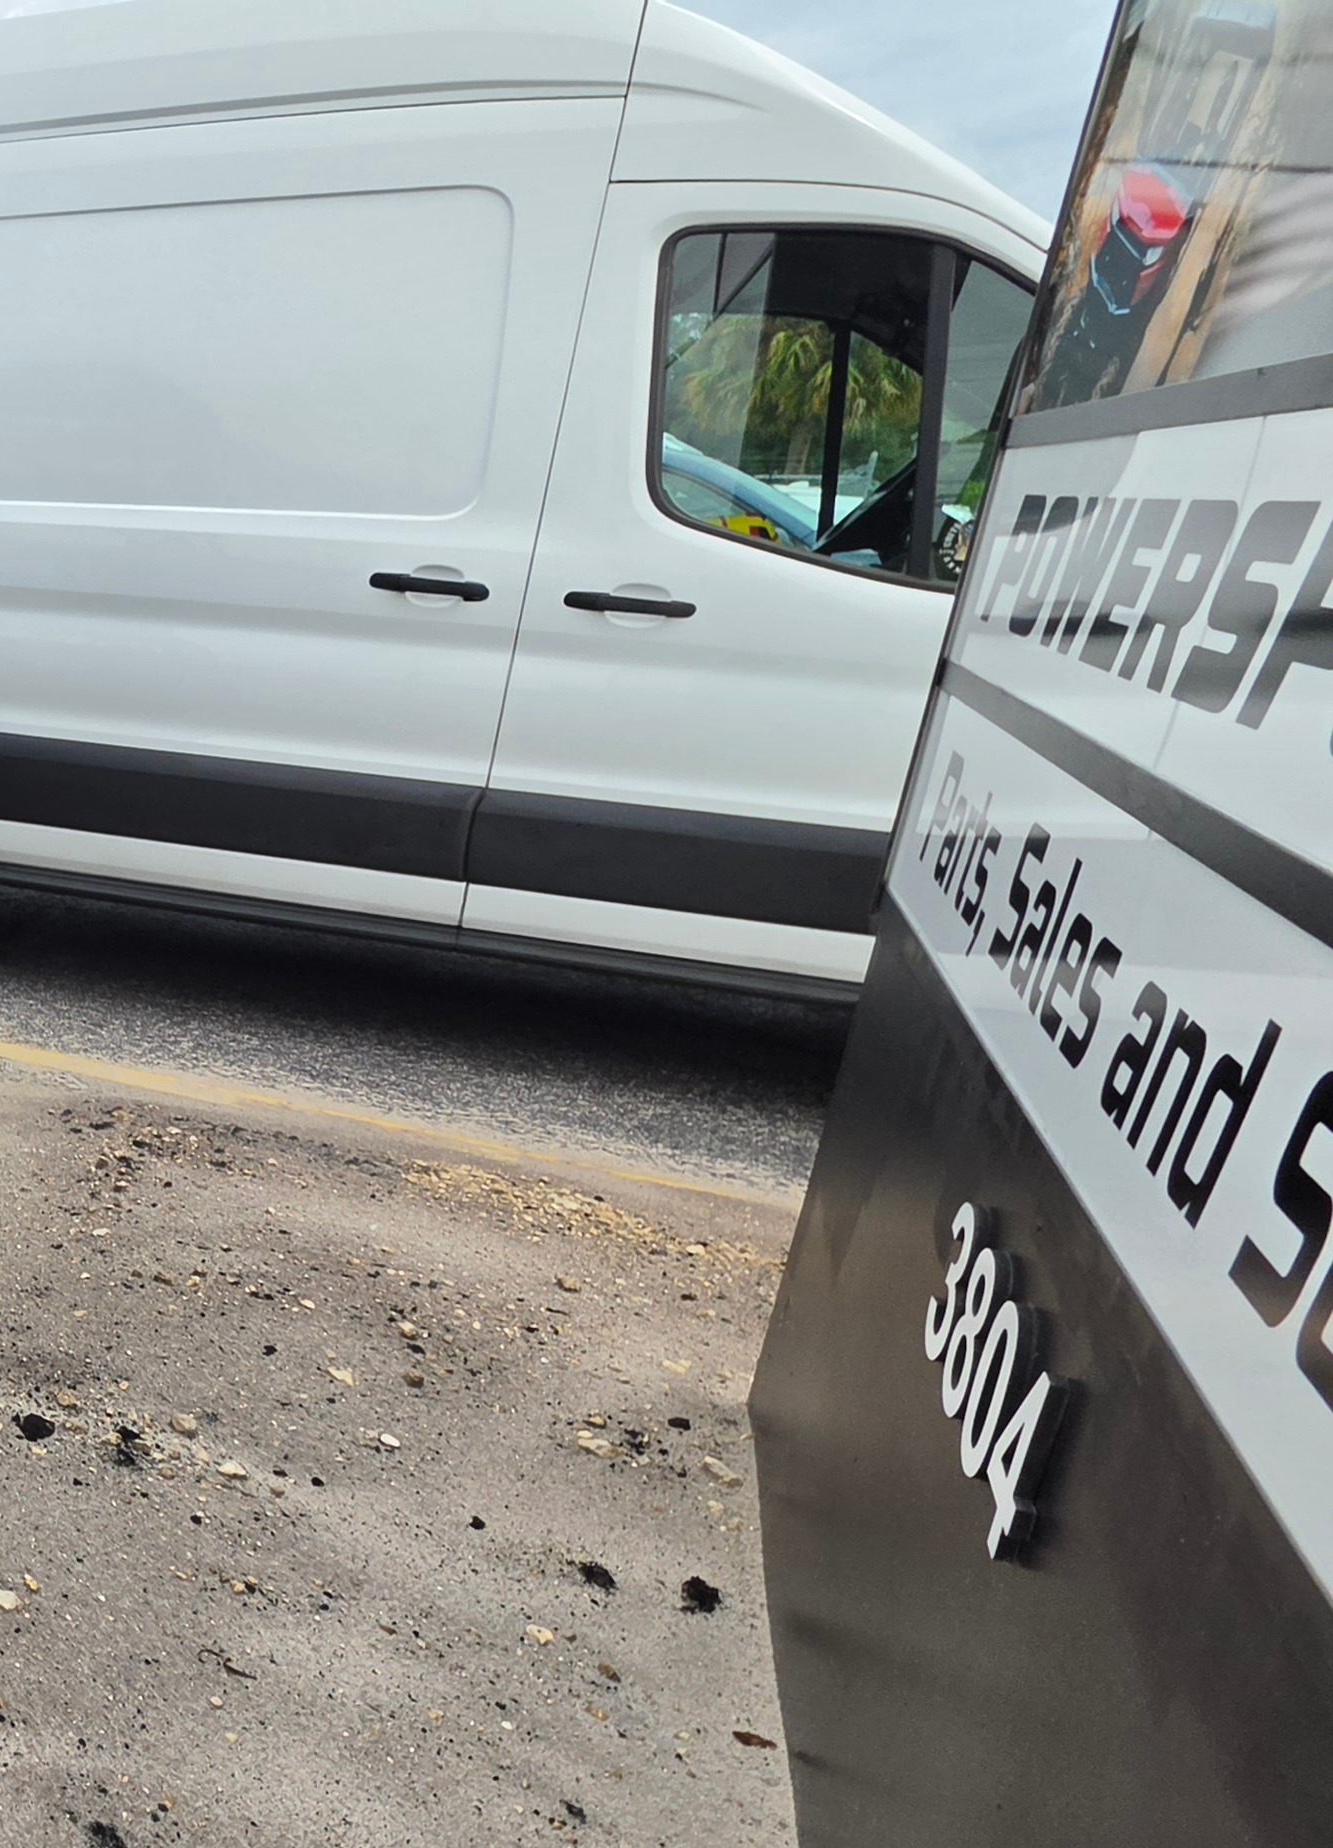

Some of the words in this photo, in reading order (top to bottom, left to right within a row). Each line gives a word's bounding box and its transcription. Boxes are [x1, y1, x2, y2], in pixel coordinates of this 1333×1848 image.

[987, 822, 1123, 1069] Sales
[1100, 980, 1283, 1230] and
[925, 1201, 1051, 1561] 3804
